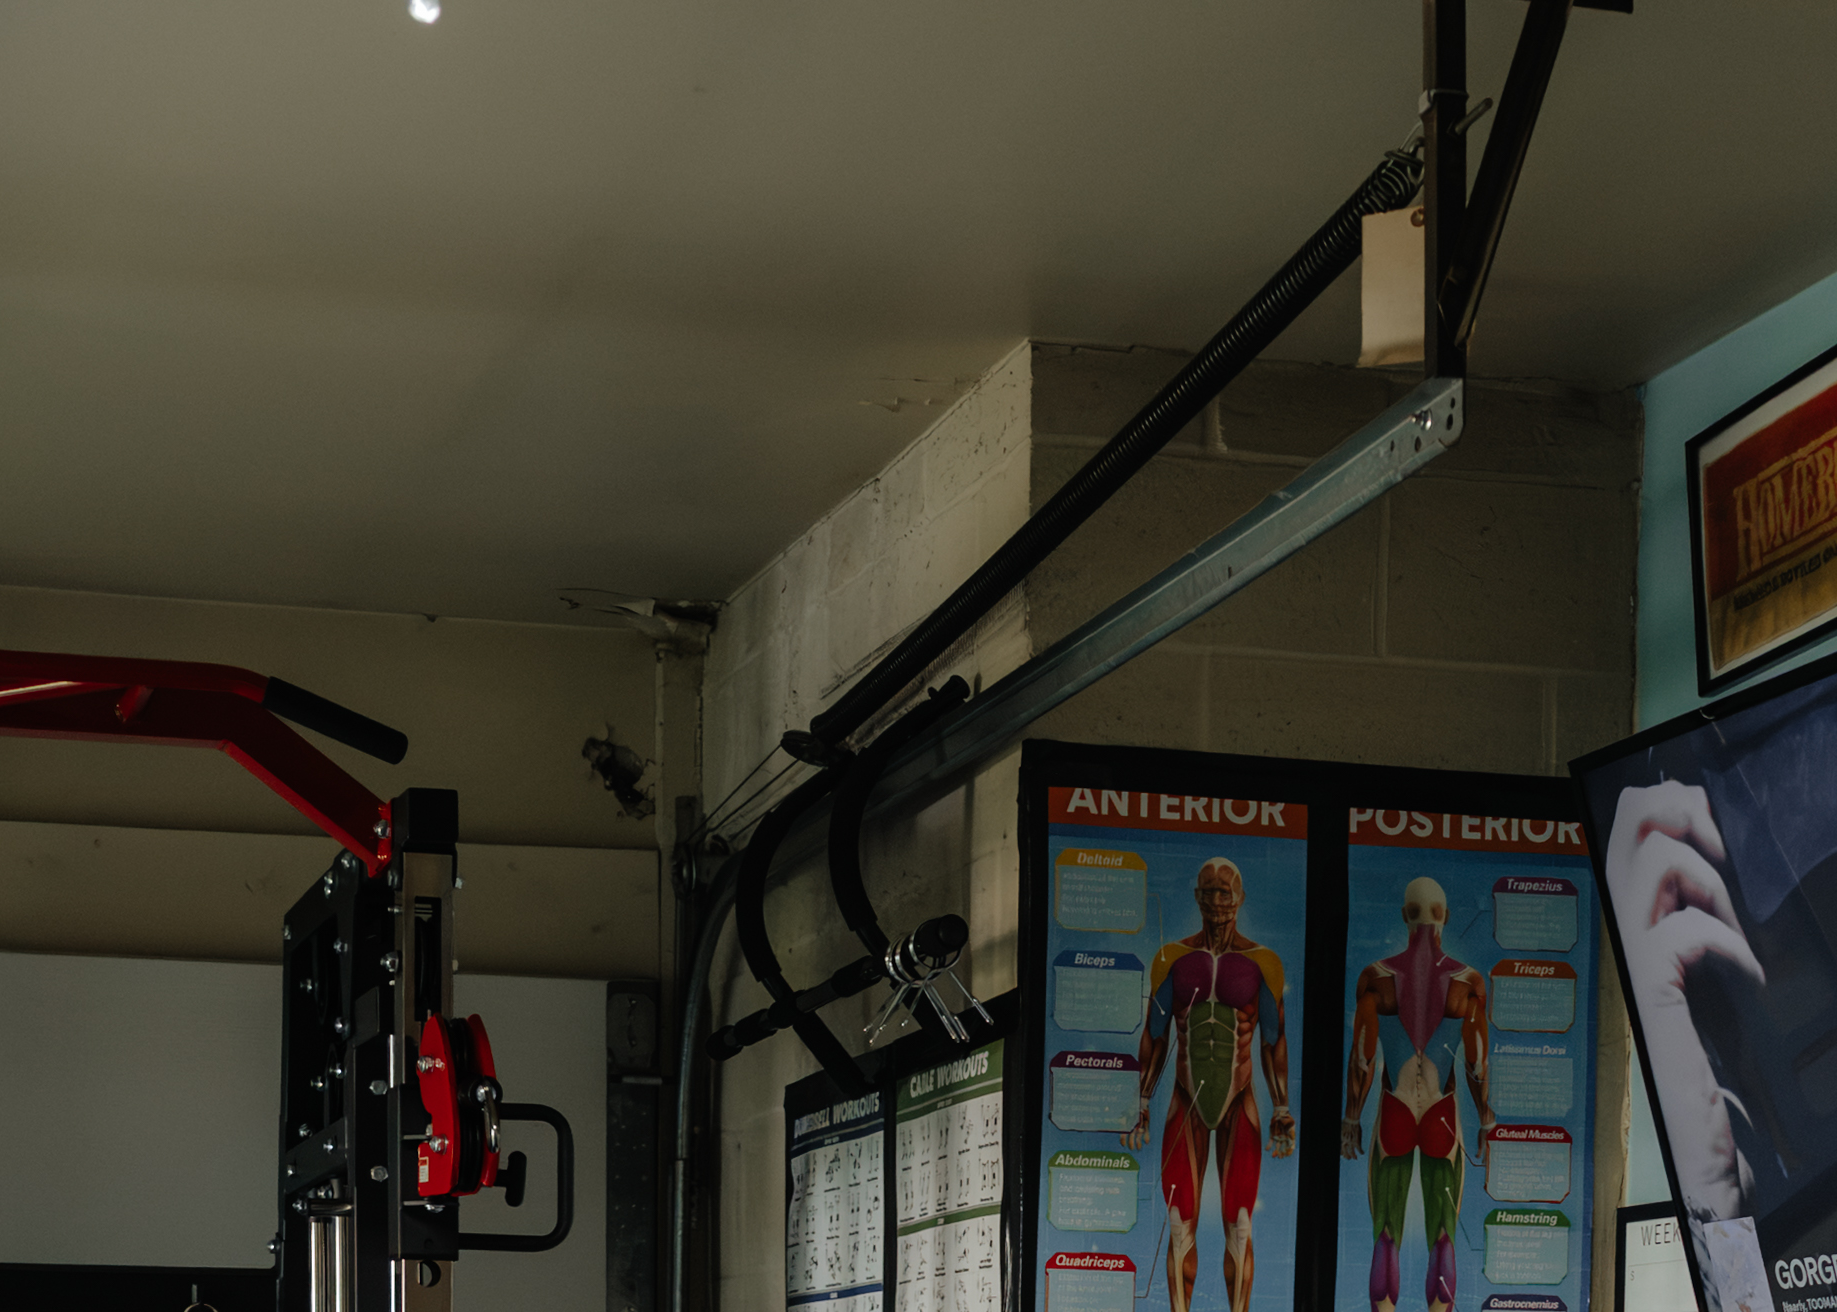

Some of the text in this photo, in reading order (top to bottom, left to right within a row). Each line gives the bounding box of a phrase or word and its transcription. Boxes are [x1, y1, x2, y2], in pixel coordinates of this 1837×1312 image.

[1066, 787, 1286, 827] ANTERIOR
[1348, 807, 1582, 844] POSTERIOR
[1076, 852, 1124, 867] Deltoid
[1506, 879, 1564, 894] Trapezius
[1074, 953, 1116, 968] Biceps
[1513, 962, 1555, 977] Triceps
[1065, 1054, 1124, 1069] Pectorals
[936, 1051, 989, 1089] WORKOUTS
[833, 1091, 880, 1125] WORKOUTS
[1496, 1128, 1528, 1139] Gluteal
[1055, 1154, 1131, 1169] Abdominals
[1496, 1211, 1558, 1226] Hamstring
[1055, 1254, 1126, 1270] Quadriceps
[1489, 1298, 1559, 1310] Gastrocnemius
